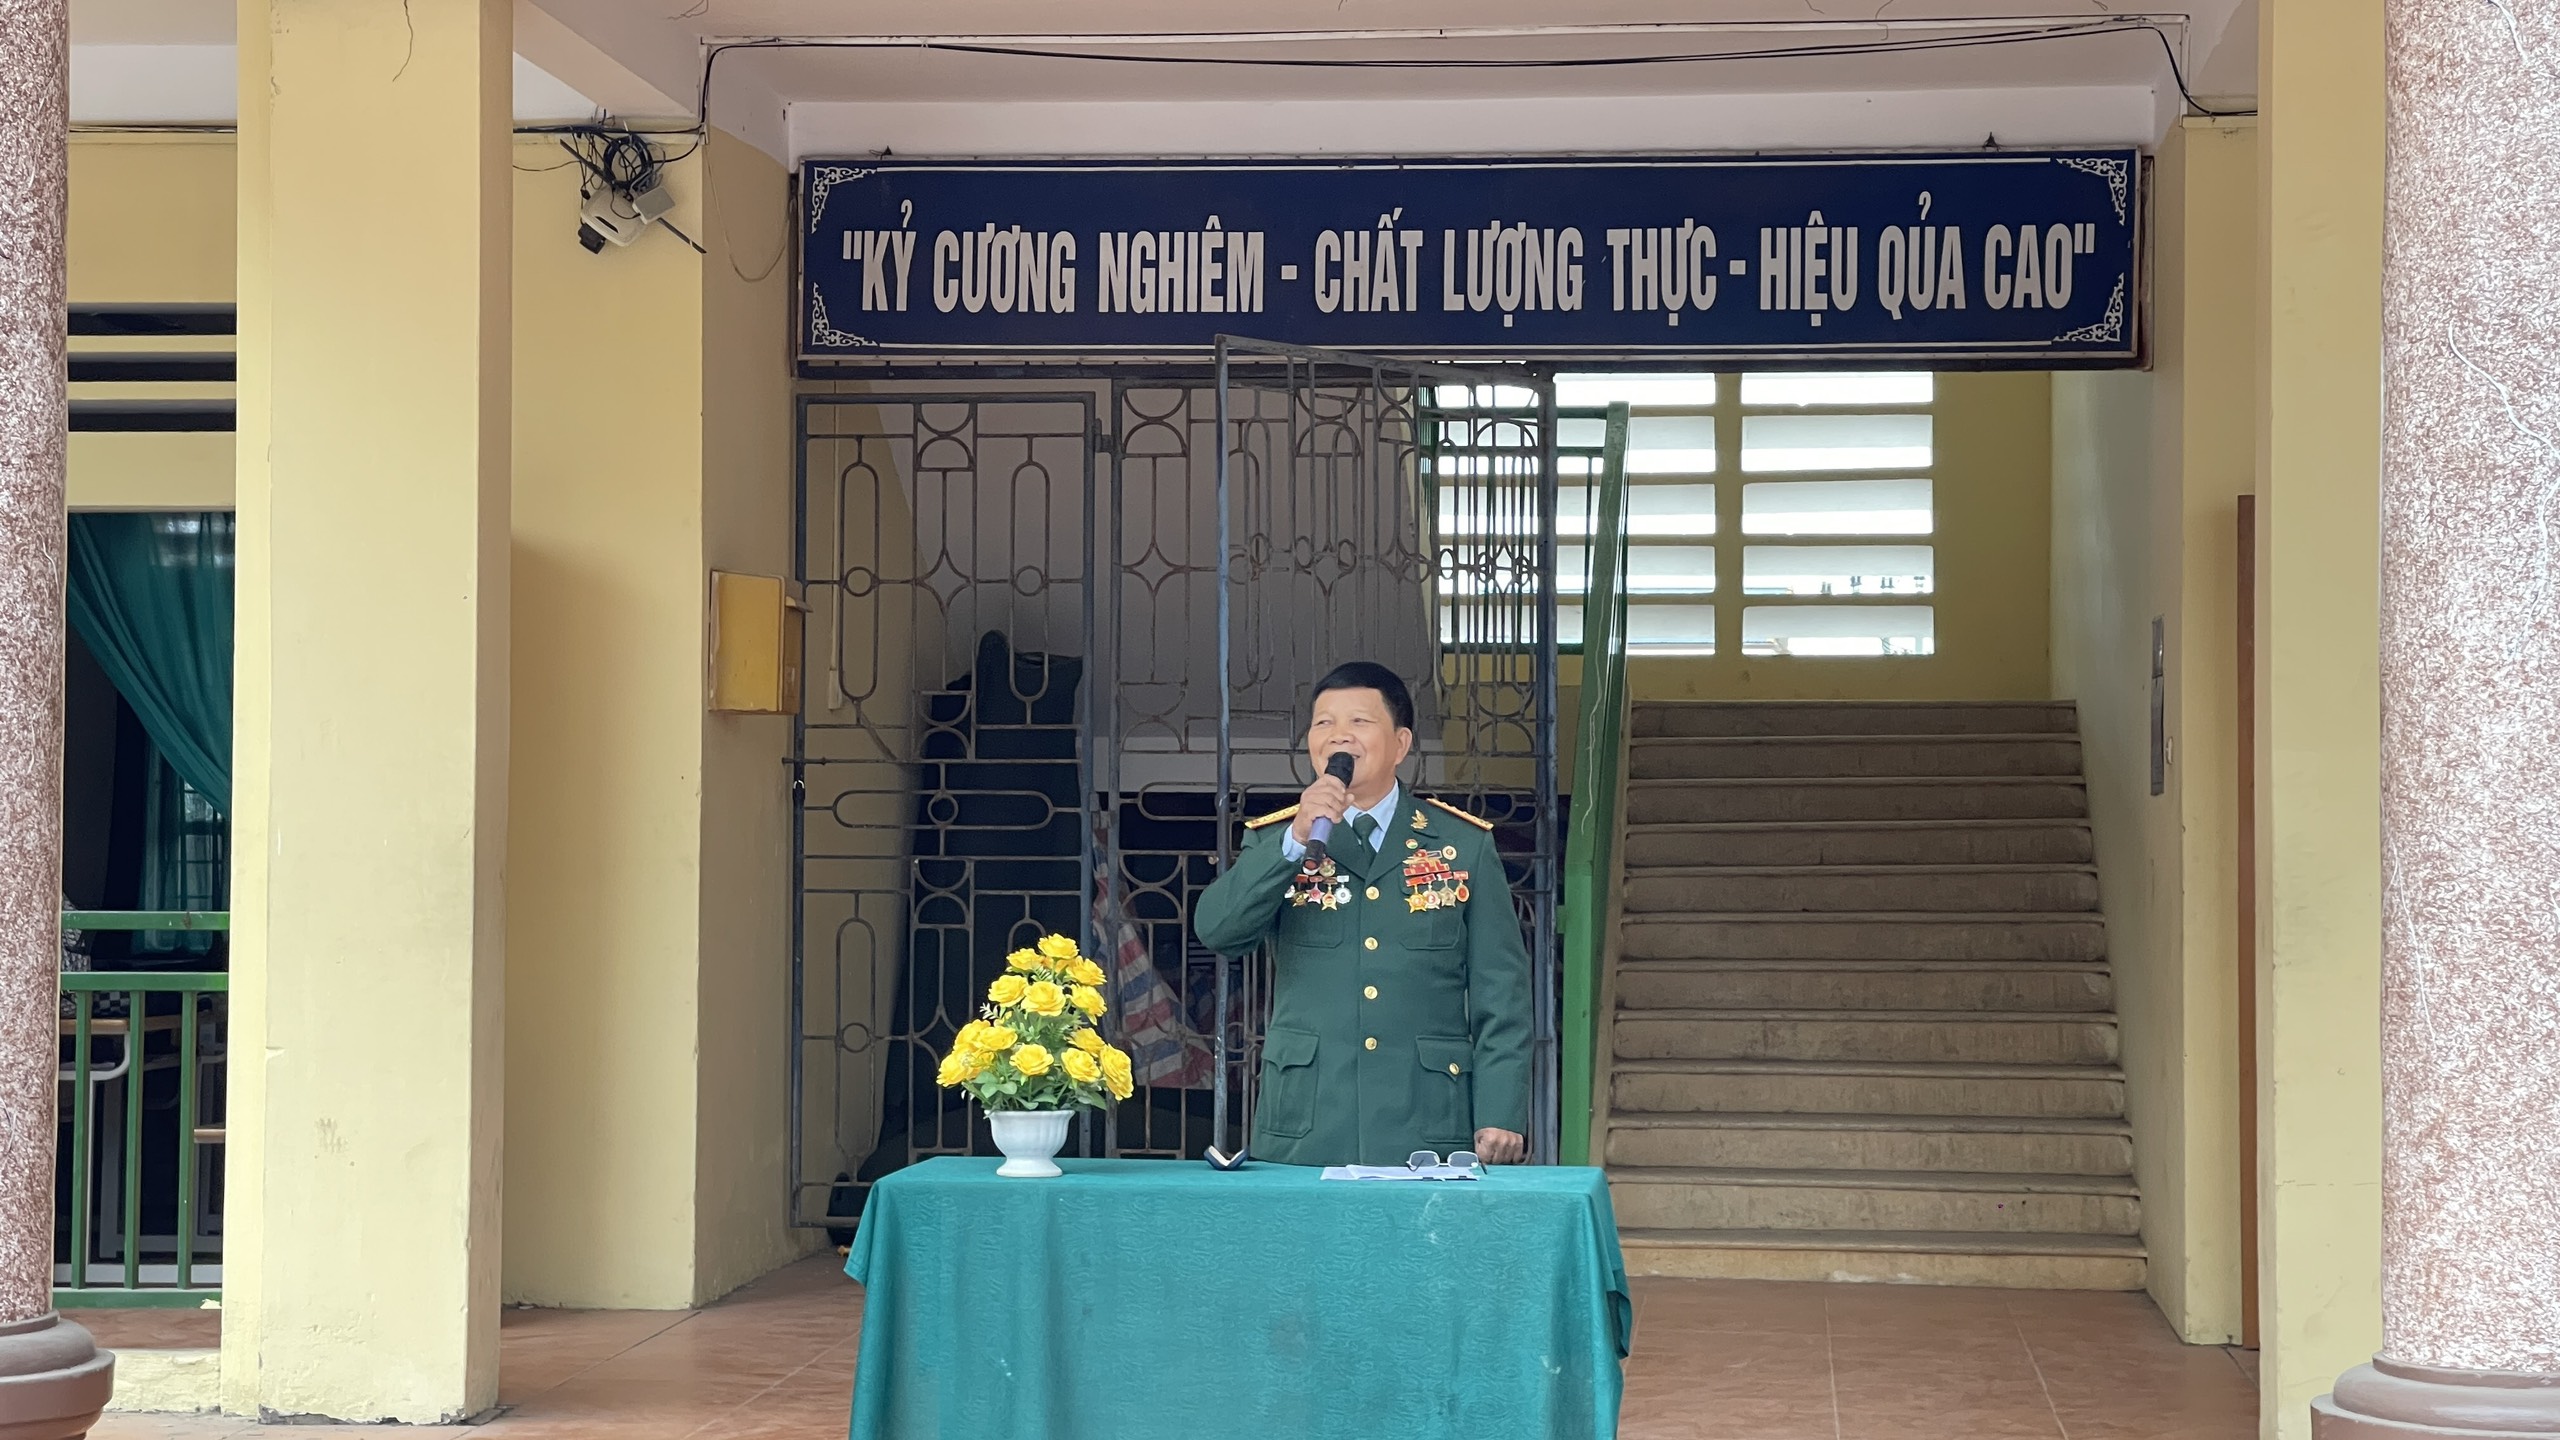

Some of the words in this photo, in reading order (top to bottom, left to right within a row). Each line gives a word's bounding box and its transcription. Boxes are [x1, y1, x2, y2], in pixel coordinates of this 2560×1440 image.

[842, 199, 917, 312] "KỶ
[933, 222, 1077, 314] CƯƠNG
[1098, 214, 1265, 313] NGHIÊM
[1314, 207, 1424, 312] CHẤT
[1443, 220, 1584, 328] LƯỢNG
[1606, 217, 1717, 327] THỰC
[1760, 210, 1858, 327] HIỆU
[1878, 190, 1966, 321] QỦA
[1984, 223, 2095, 310] CAO"
